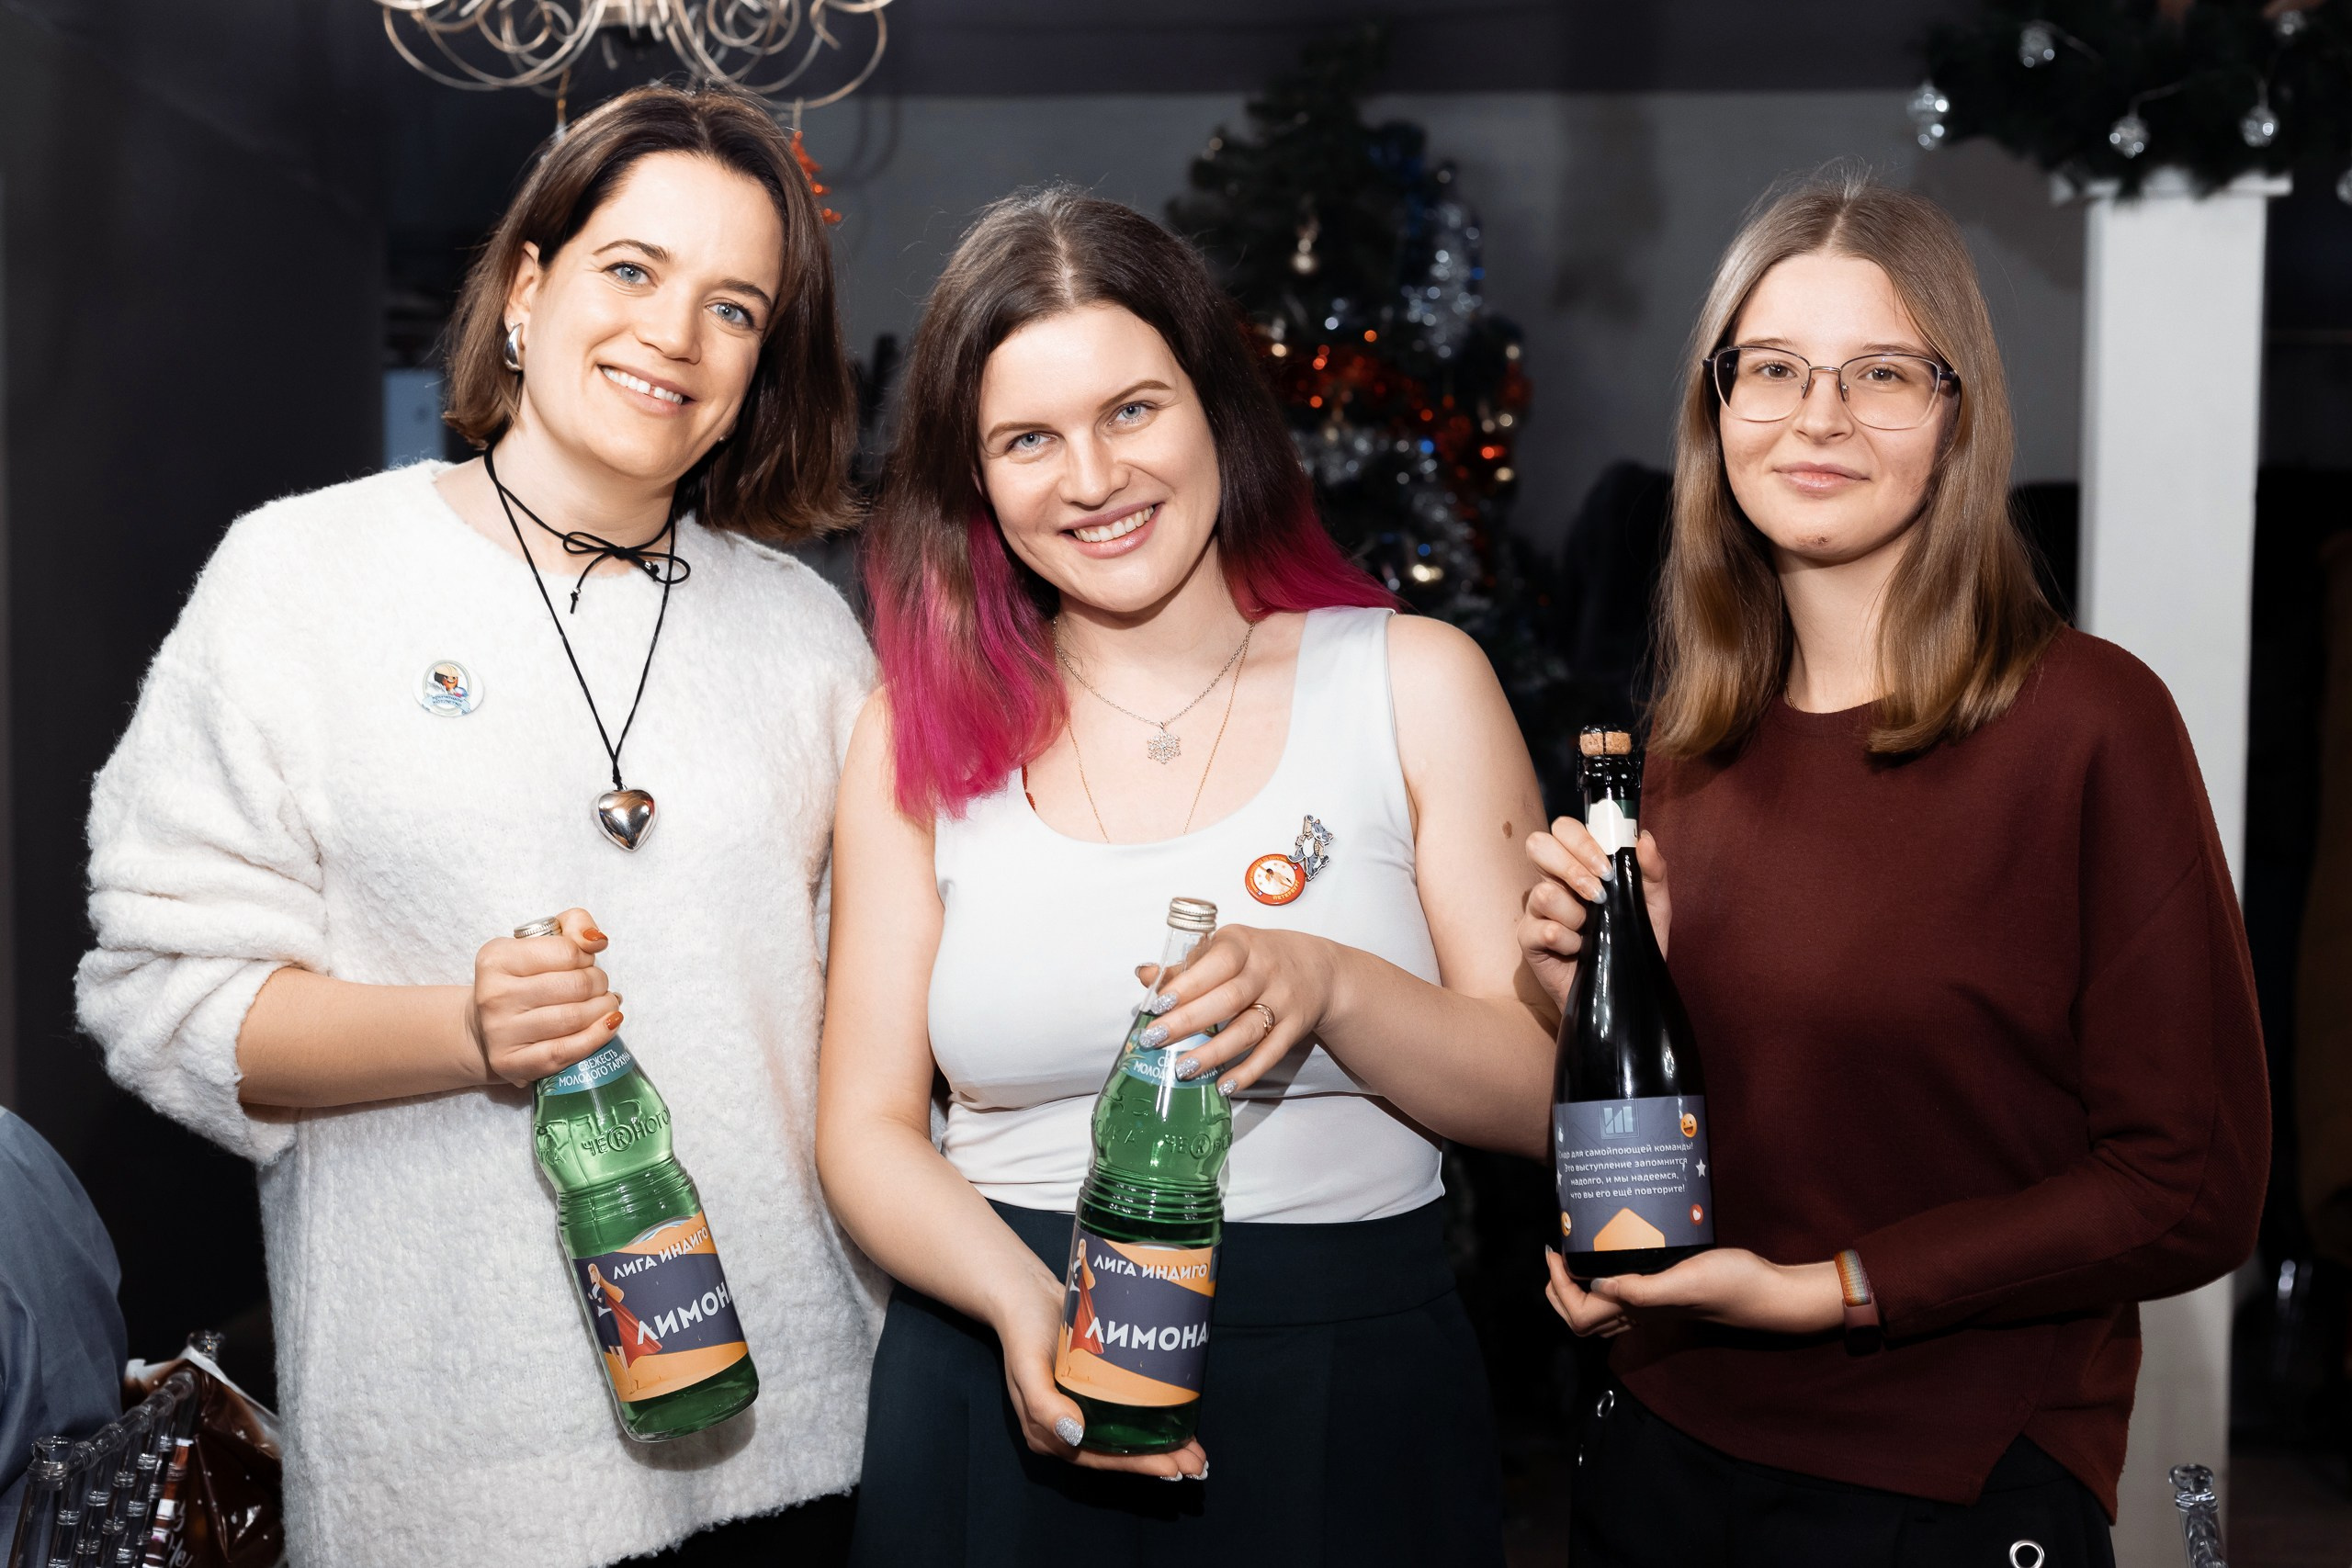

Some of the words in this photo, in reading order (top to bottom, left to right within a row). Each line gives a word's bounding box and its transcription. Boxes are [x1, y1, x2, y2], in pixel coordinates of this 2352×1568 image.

[578, 1049, 618, 1072] СВЕЖЕСТЬ
[559, 1066, 608, 1087] МОЛОДОГО
[1571, 1150, 1584, 1159] для
[1585, 1145, 1652, 1157] самойпоющей
[1655, 1142, 1694, 1152] команды!
[1564, 1163, 1575, 1172] Это
[1576, 1161, 1633, 1172] выступление
[1634, 1157, 1688, 1168] запомнится
[1570, 1177, 1604, 1186] надолго,
[1631, 1172, 1679, 1182] надеемся,
[1612, 1187, 1633, 1198] ещё
[1634, 1183, 1686, 1196] повторите!
[614, 1255, 658, 1280] ЛИГА
[659, 1226, 709, 1264] ИНДИГО
[1093, 1254, 1136, 1277] ЛИГА
[1141, 1263, 1208, 1280] ИНДИГО
[637, 1281, 733, 1346] ЛИМОН
[1085, 1316, 1210, 1351] ЛИМОНА
